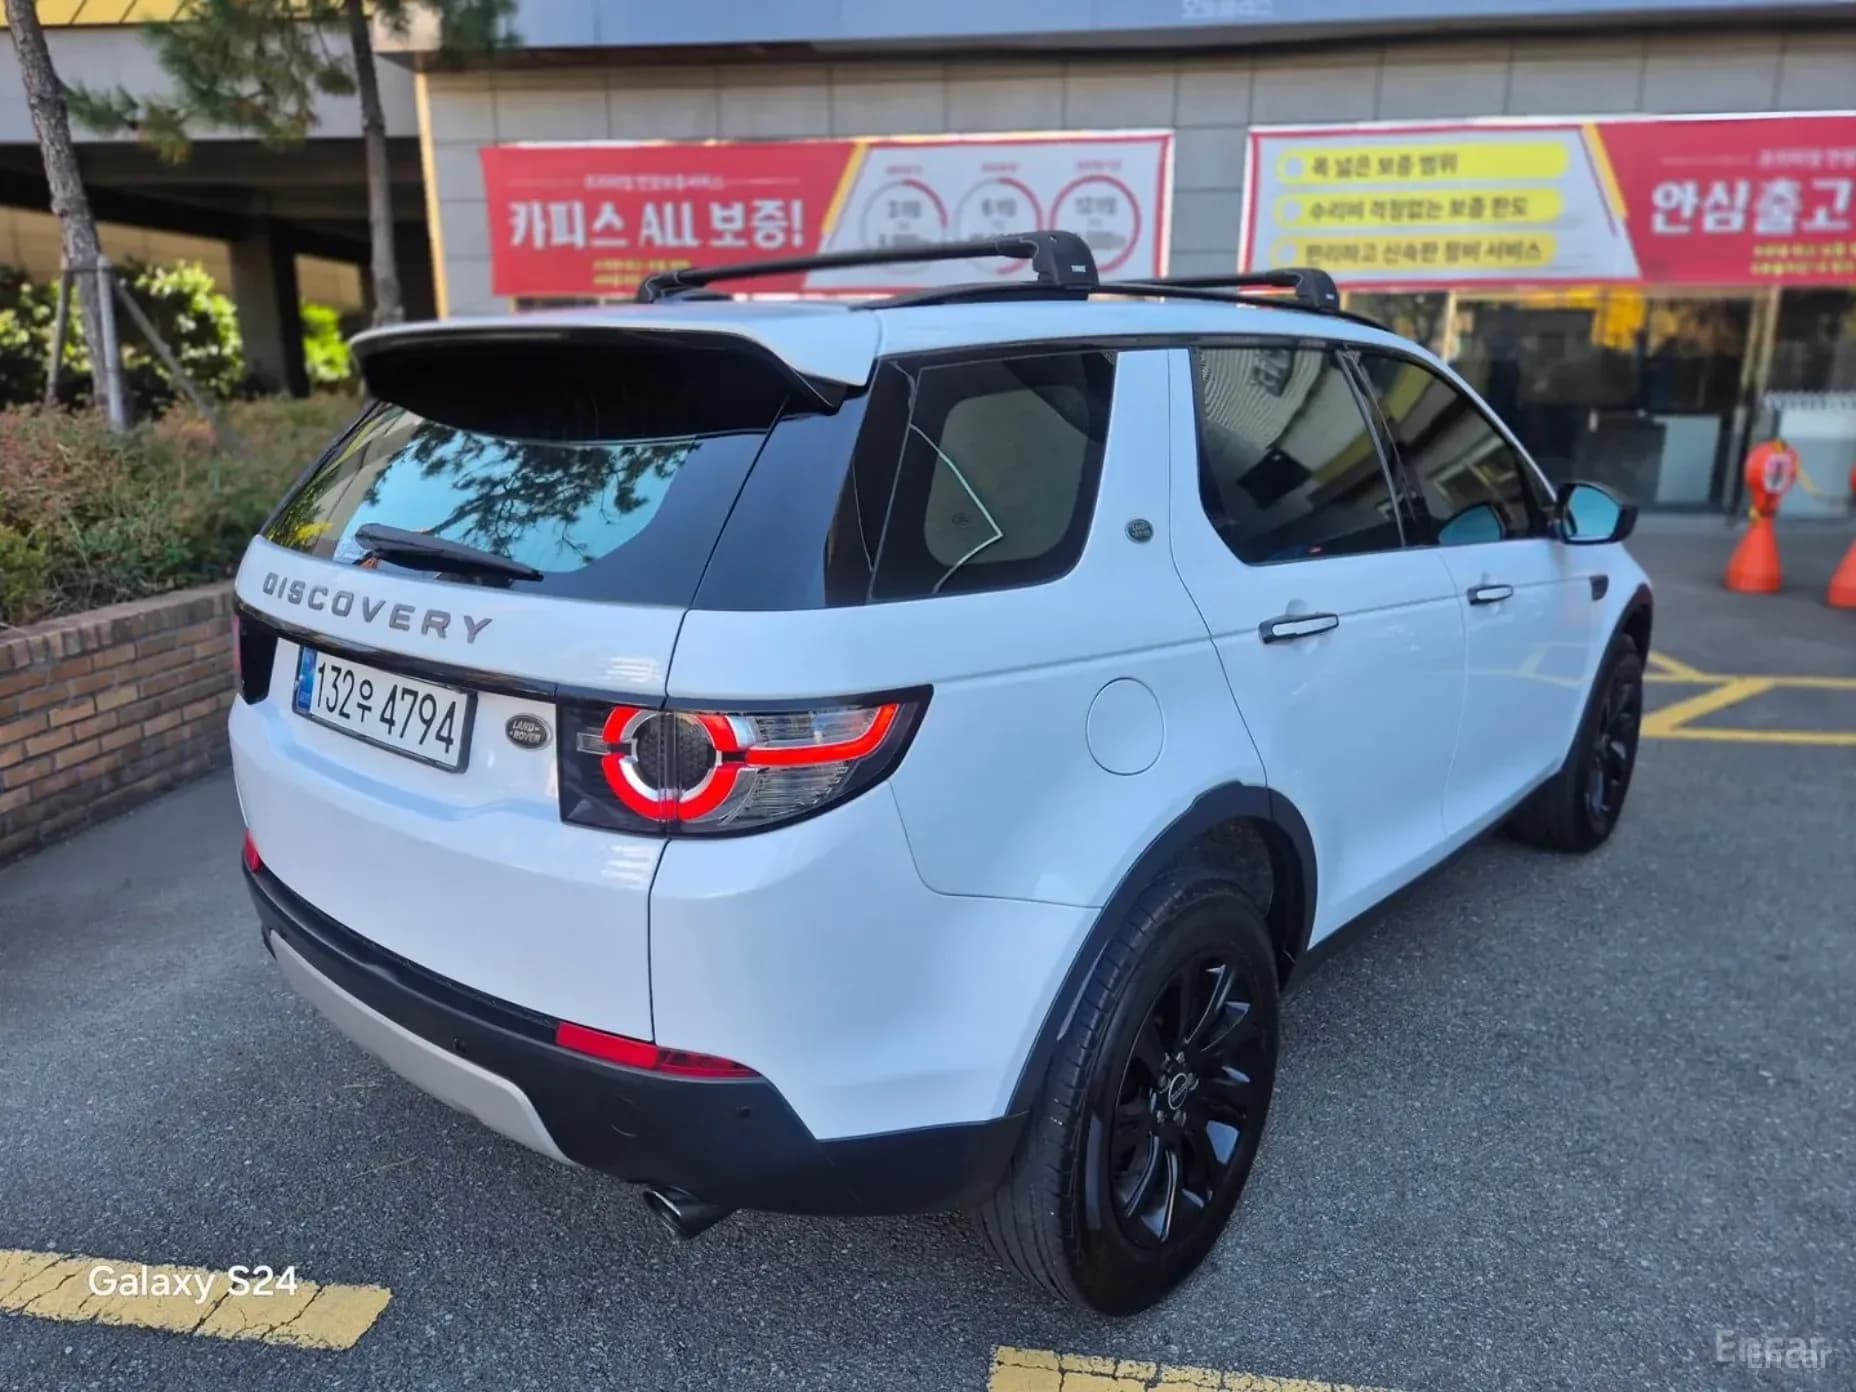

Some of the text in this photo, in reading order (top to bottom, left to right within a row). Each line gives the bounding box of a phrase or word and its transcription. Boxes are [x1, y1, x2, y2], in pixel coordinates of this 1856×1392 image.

[508, 198, 805, 249] 카피스 ALL 보증!
[1485, 239, 1542, 261] 서비스
[262, 571, 493, 644] DISCOVERY
